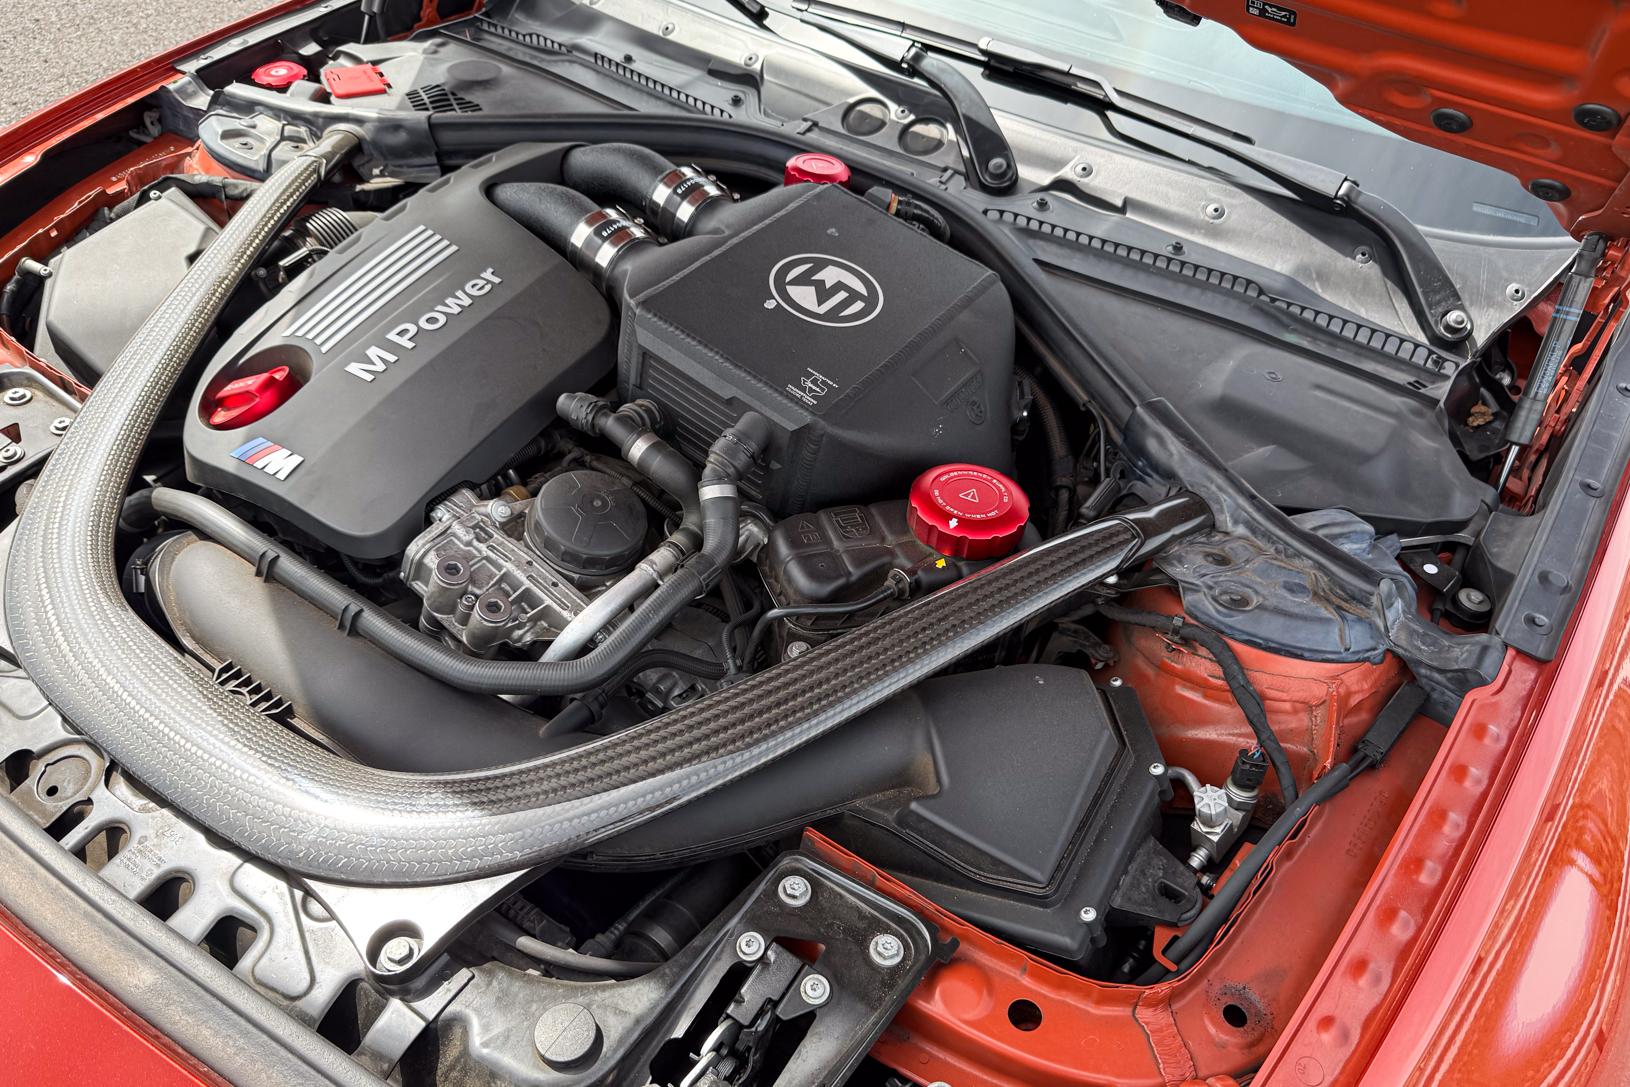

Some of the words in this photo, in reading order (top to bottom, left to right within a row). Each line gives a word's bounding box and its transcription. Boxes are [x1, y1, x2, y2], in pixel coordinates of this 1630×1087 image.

[344, 345, 399, 382] M
[385, 267, 503, 350] Power
[936, 496, 946, 506] NOT
[945, 505, 963, 516] OPEN
